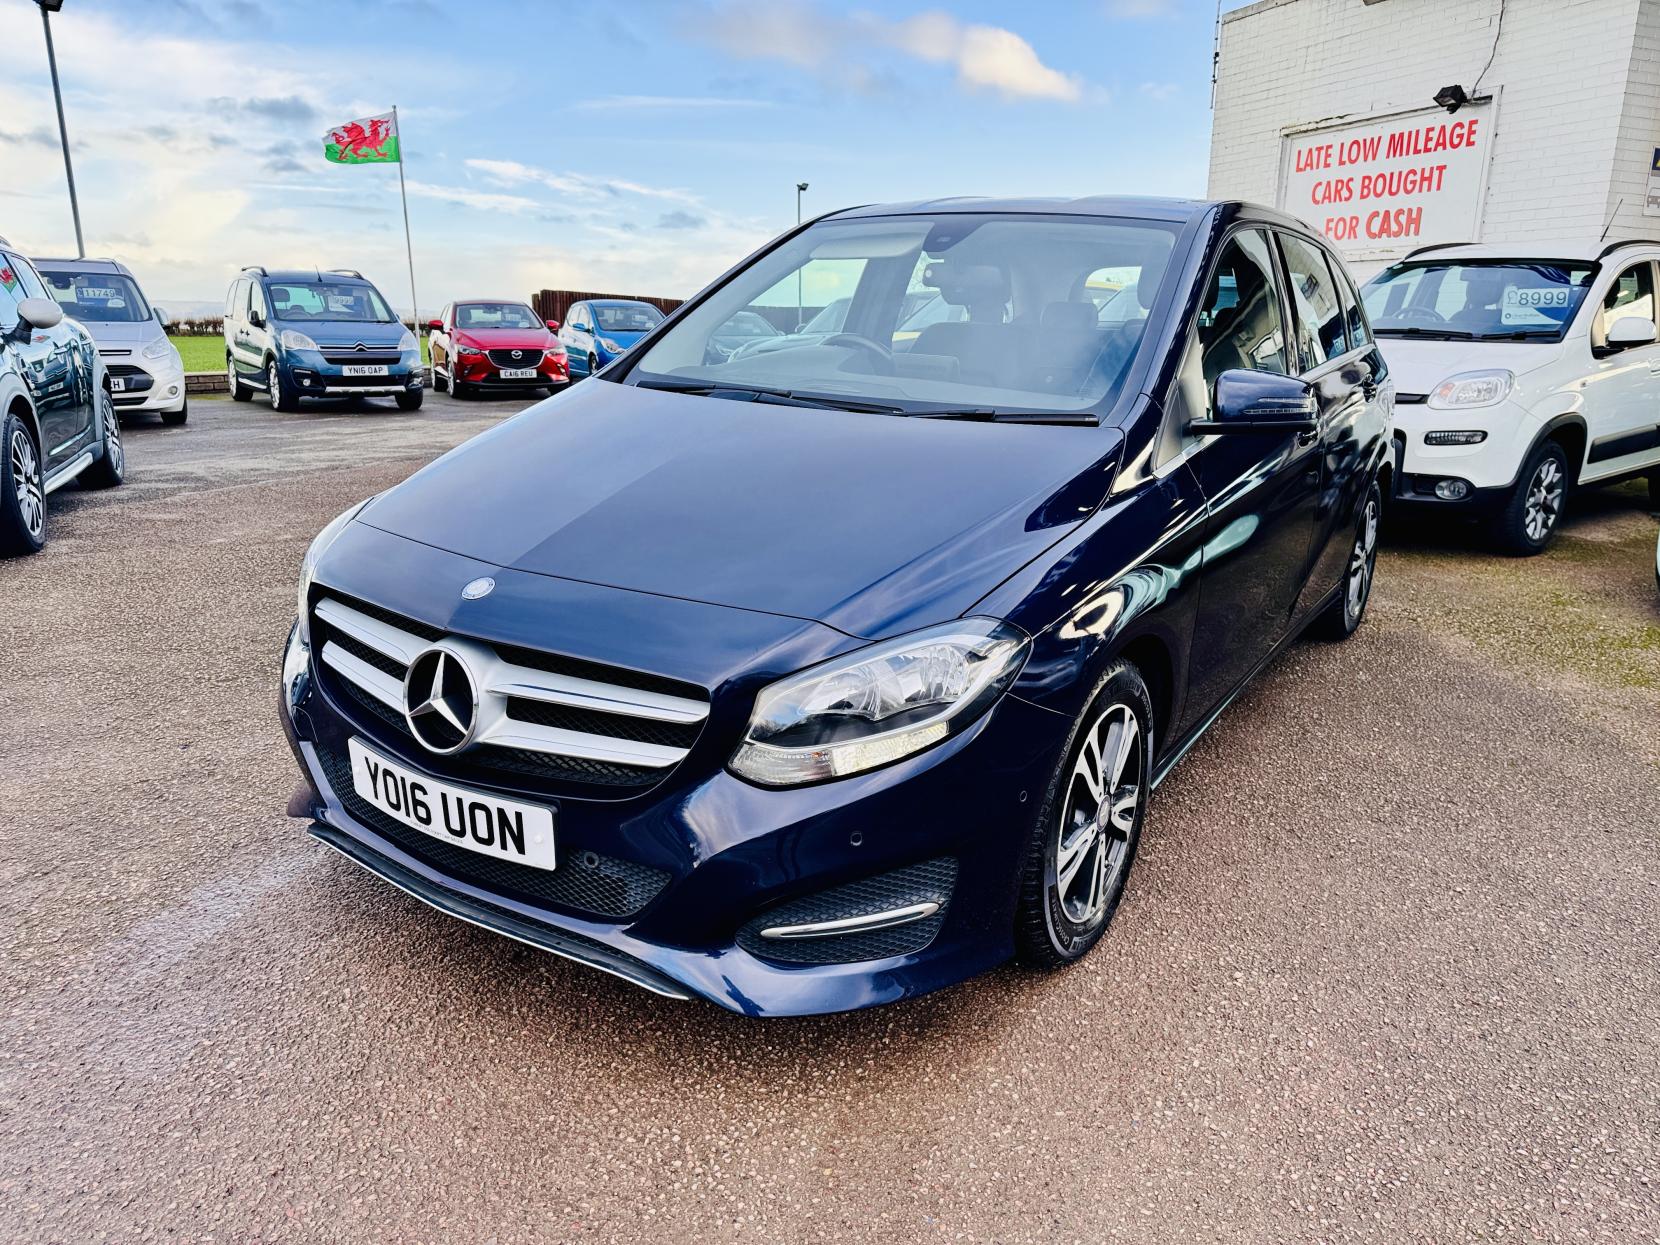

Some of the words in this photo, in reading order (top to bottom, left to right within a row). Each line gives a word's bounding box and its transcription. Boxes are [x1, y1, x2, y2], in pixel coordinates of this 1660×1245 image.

[1296, 144, 1333, 173] LATE
[1338, 136, 1382, 166] LOW
[1386, 120, 1479, 159] MILEAGE
[1312, 177, 1354, 205] CARS
[1360, 165, 1447, 200] BOUGHT
[1325, 216, 1359, 241] FOR
[1366, 207, 1422, 239] CASH
[1507, 290, 1567, 305] £8999
[347, 366, 366, 375] YN16
[364, 756, 432, 826] YO16
[440, 792, 526, 855] UON
